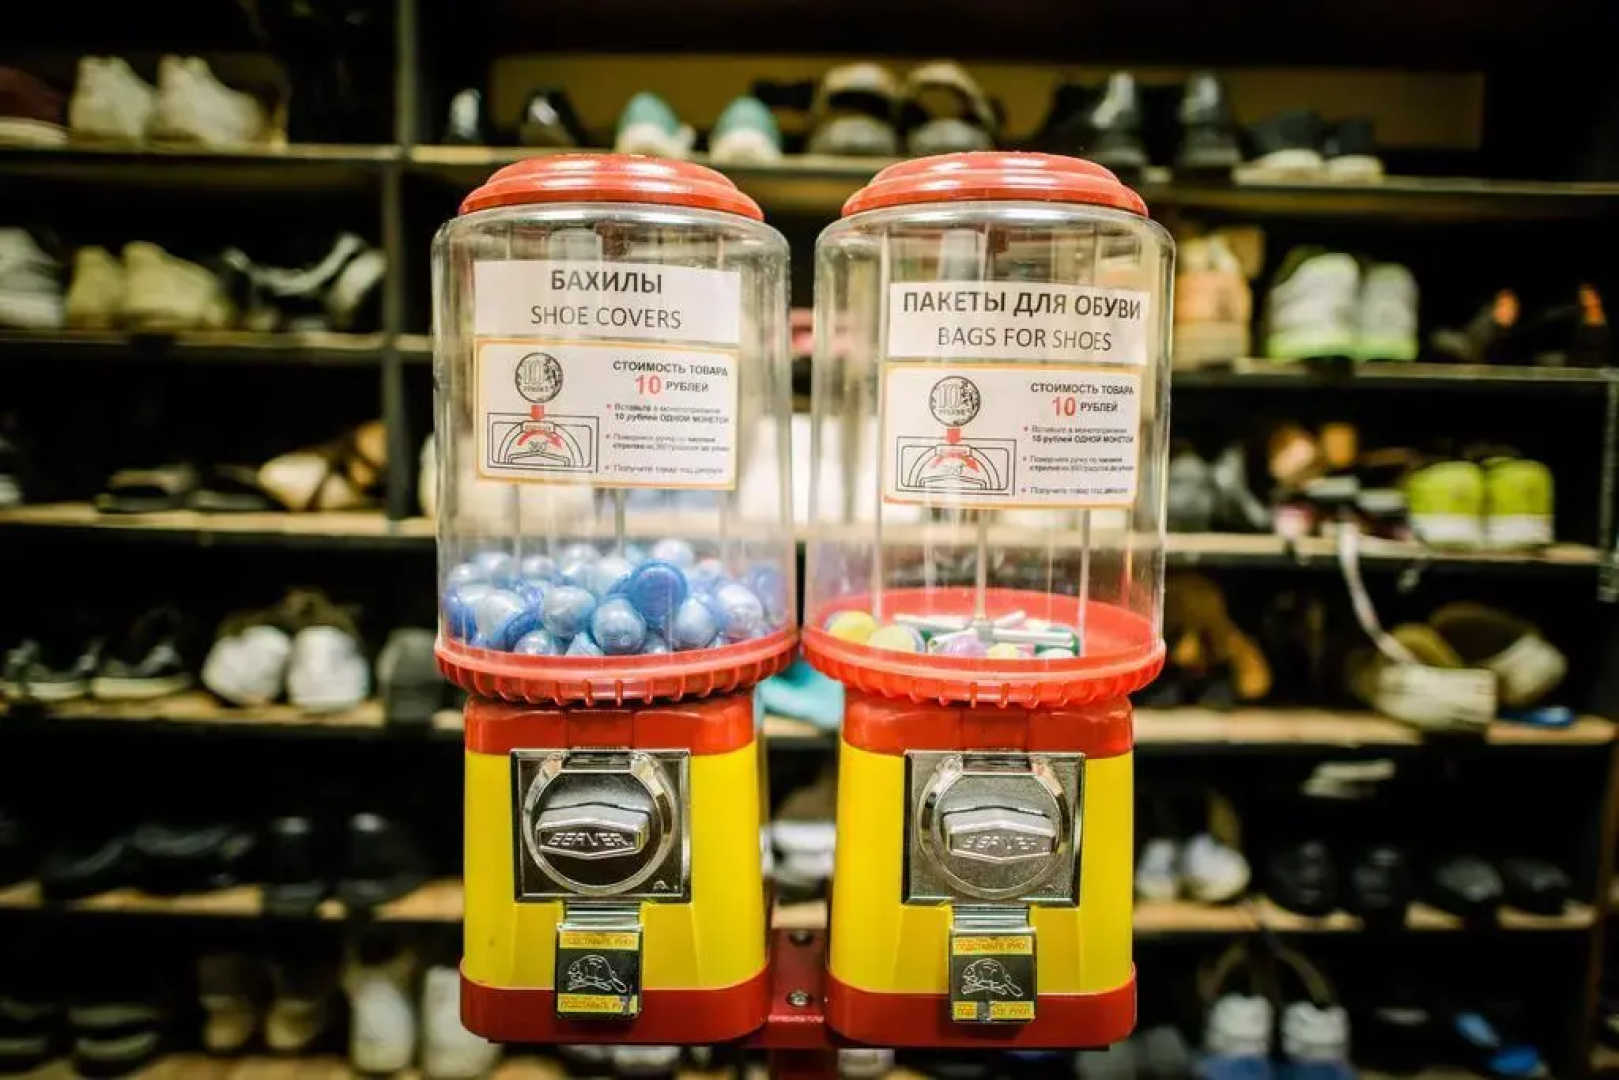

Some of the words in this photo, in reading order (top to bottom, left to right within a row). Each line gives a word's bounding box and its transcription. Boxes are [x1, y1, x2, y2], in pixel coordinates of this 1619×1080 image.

[551, 270, 662, 294] БАХИЛЫ
[904, 291, 1006, 313] ПАКЕТЫ
[1013, 292, 1067, 317] ДЛЯ
[1074, 295, 1141, 320] ОБУВИ
[531, 305, 588, 326] SHOE
[596, 307, 682, 329] COVERS
[938, 327, 997, 347] BAGS
[1004, 328, 1046, 348] FOR
[1052, 329, 1112, 352] SHOES
[613, 360, 686, 374] СТОИМОСТЬ
[689, 365, 729, 377] ТОВАРА
[634, 374, 661, 395] 10
[666, 380, 710, 393] РУБЛЕЙ
[1030, 382, 1099, 395] СТОИМОСТЬ
[1101, 385, 1134, 395] ТОВАРА
[1052, 396, 1076, 417] 10
[1080, 400, 1119, 412] РУБЛЕЙ
[1074, 434, 1101, 444] ОДНОЙ
